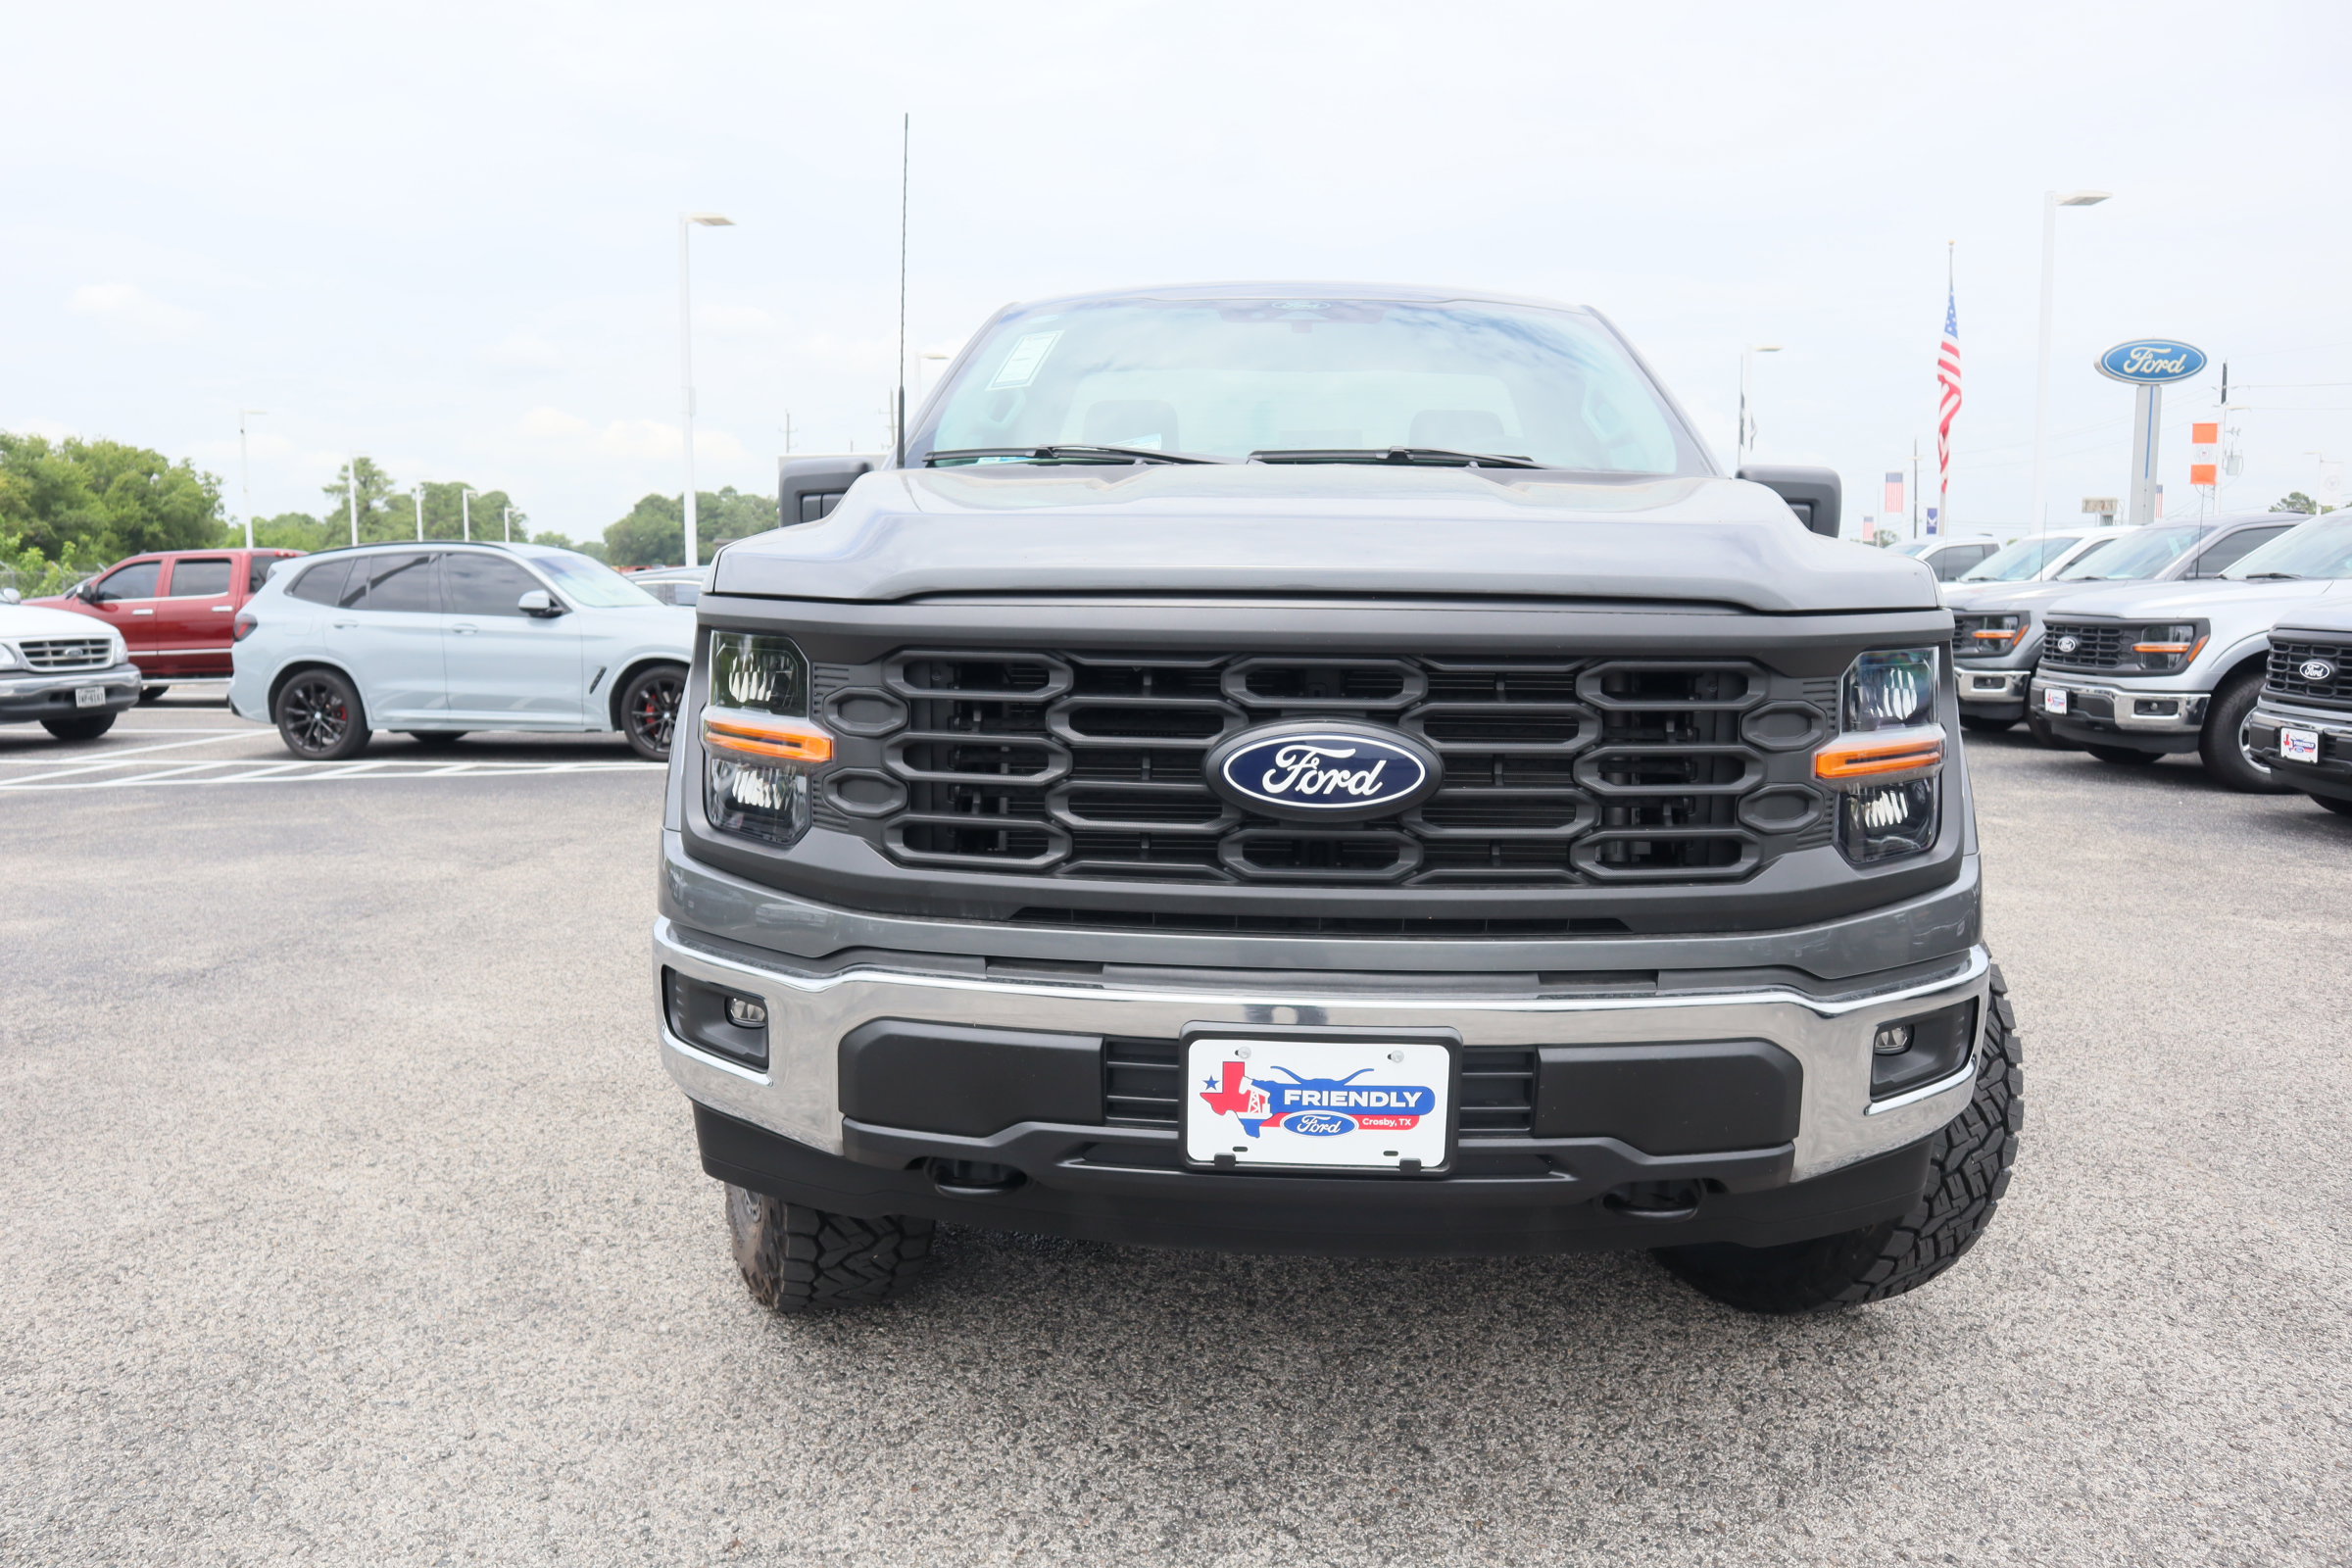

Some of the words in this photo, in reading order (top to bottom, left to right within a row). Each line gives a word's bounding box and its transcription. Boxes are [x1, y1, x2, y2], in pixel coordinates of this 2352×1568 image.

[2123, 346, 2187, 373] Ford
[2304, 663, 2324, 677] Ford
[1262, 744, 1387, 796] Ford
[1284, 1089, 1423, 1108] FRIENDLY
[1296, 1114, 1341, 1135] Ford
[1362, 1117, 1398, 1128] Crosby,
[1399, 1117, 1412, 1127] TX
